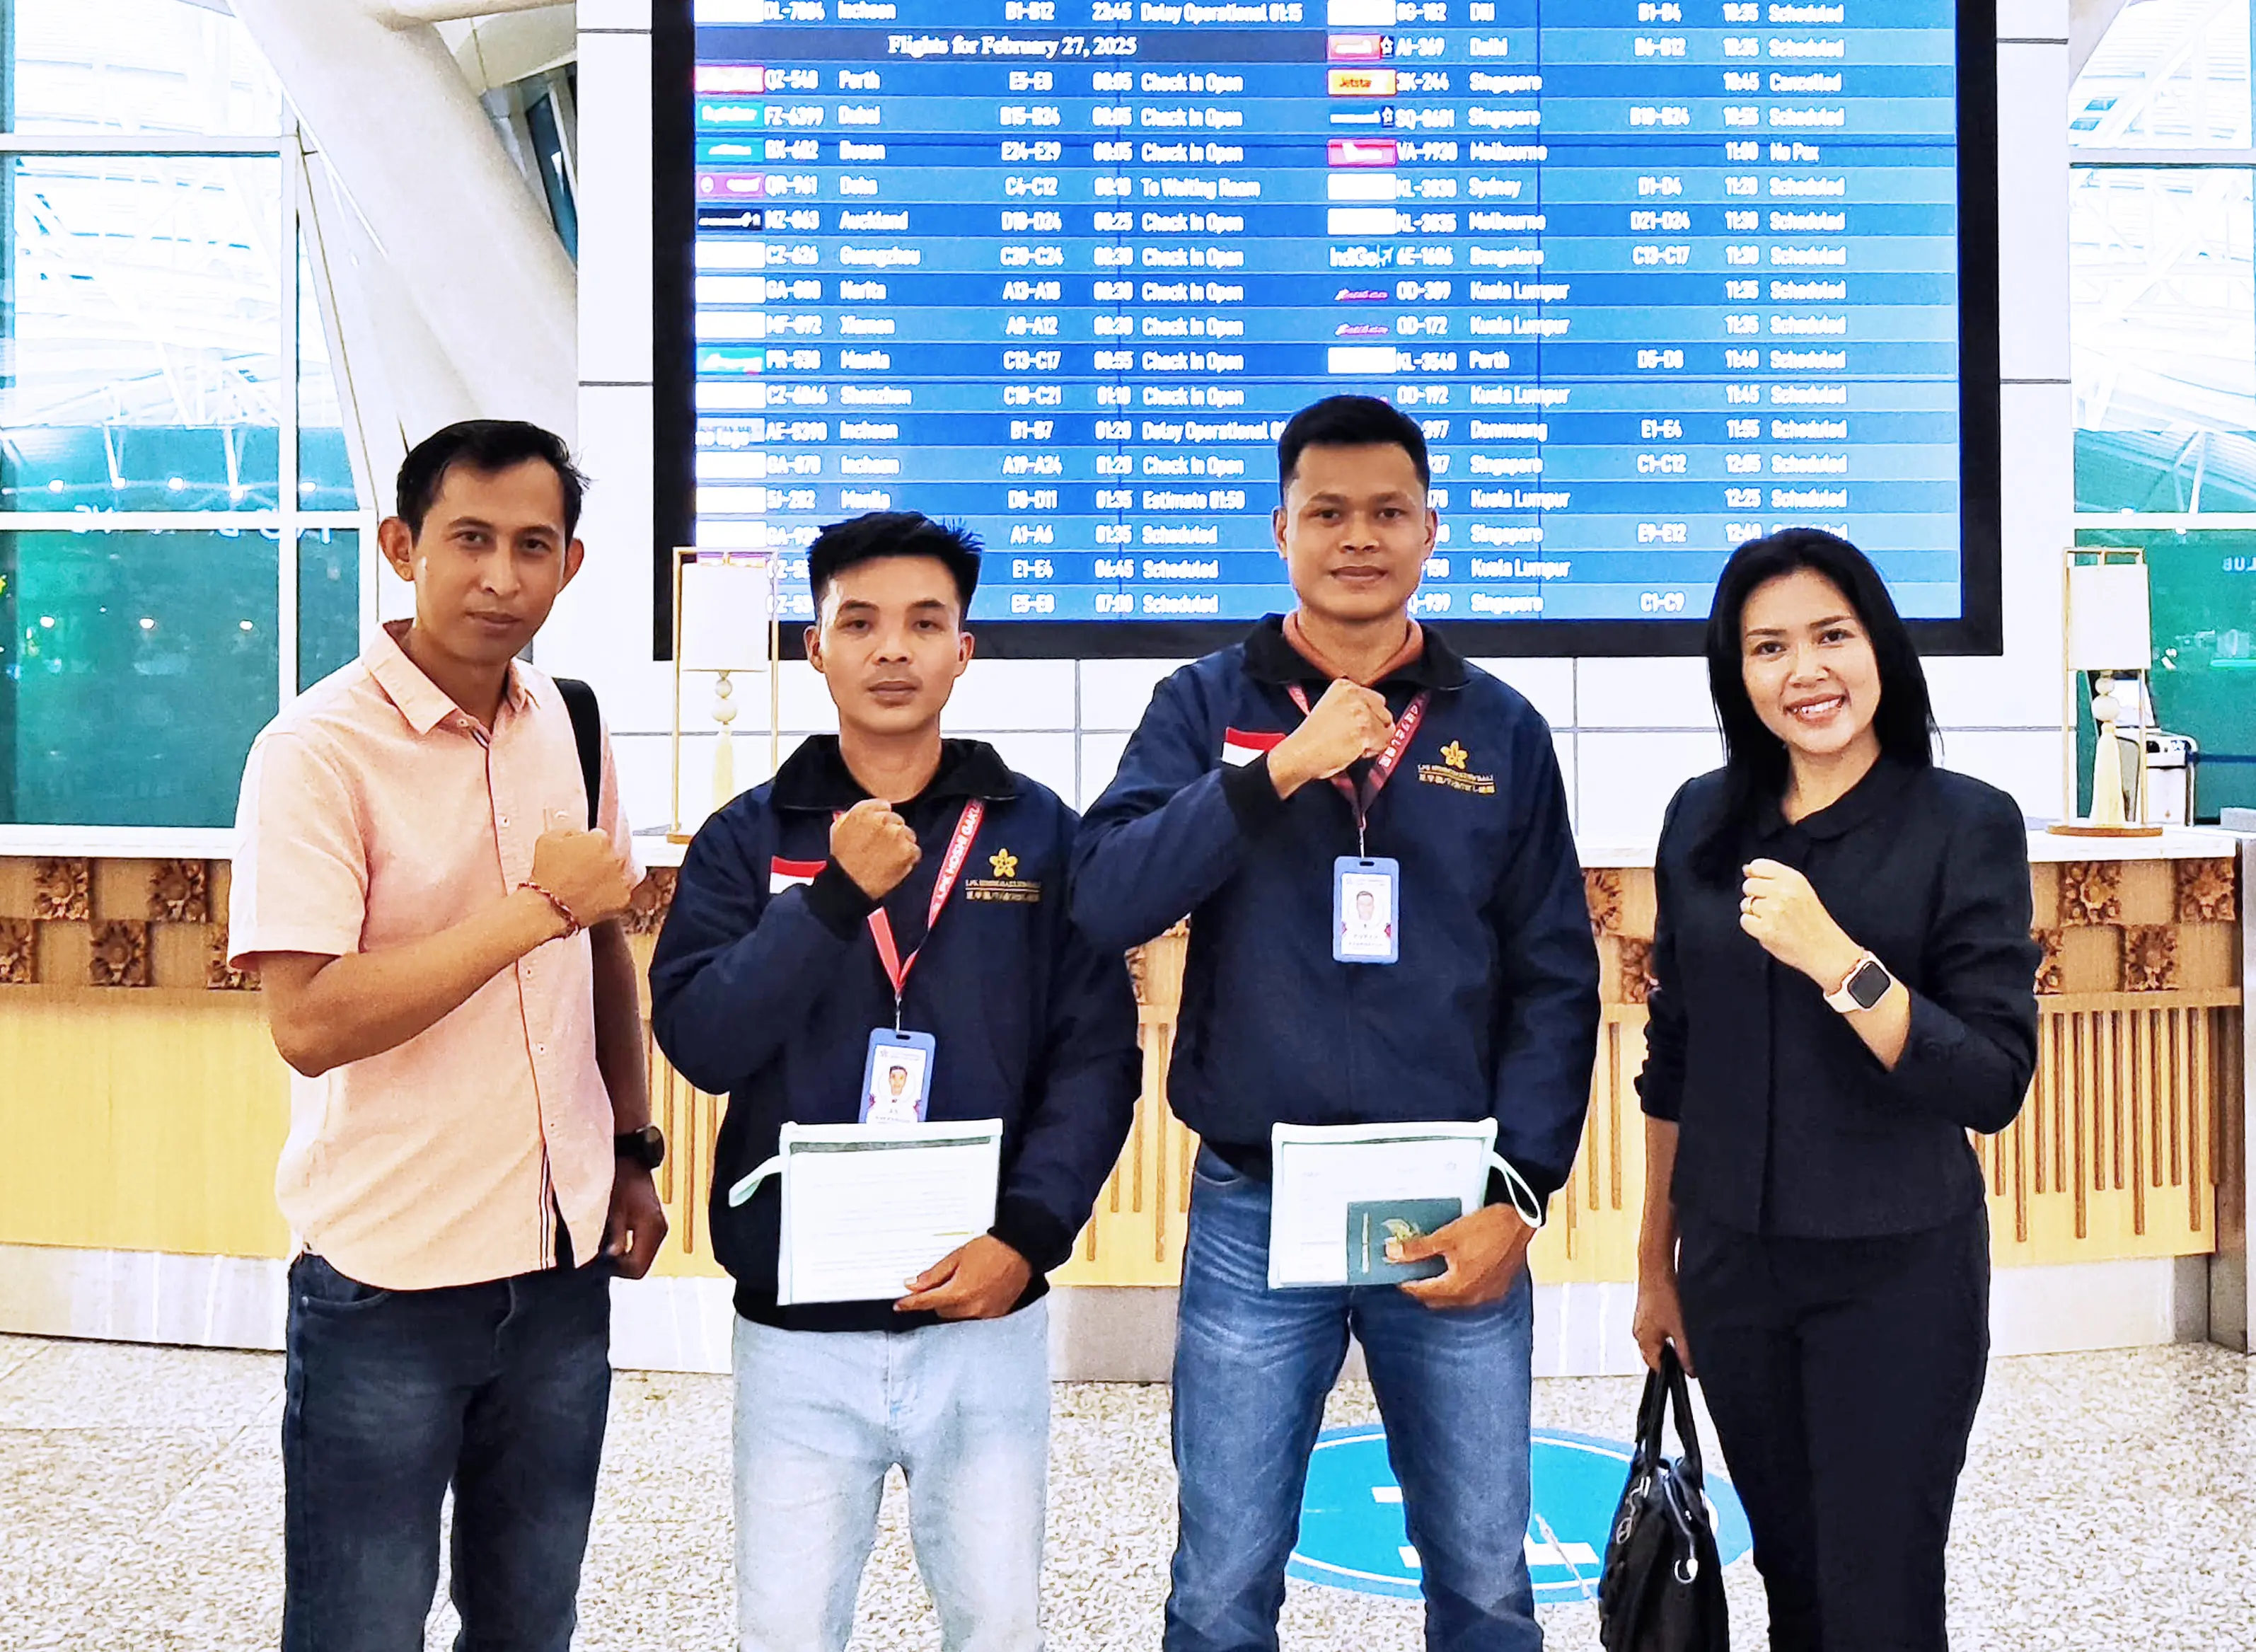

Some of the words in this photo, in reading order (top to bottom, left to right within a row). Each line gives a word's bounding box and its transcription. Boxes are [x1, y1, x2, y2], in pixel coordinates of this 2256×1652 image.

[1140, 2, 1183, 24] Delay
[1184, 2, 1268, 24] Operational
[1768, 4, 1844, 21] Scheduled
[888, 35, 949, 58] Flights
[951, 35, 980, 54] for
[981, 35, 1059, 59] February
[1061, 36, 1090, 58] 27,
[1092, 36, 1137, 55] 2025
[1469, 37, 1508, 57] Delhi
[1768, 37, 1845, 55] Scheduled
[838, 70, 880, 89] Perth
[1141, 72, 1188, 91] Check
[1205, 72, 1244, 93] Open
[1469, 71, 1543, 93] Singapore
[1769, 73, 1842, 90] Cancelled
[838, 105, 881, 125] Dubai
[1140, 108, 1188, 127] Check
[1205, 108, 1243, 128] Open
[1468, 107, 1541, 127] Singapore
[1769, 107, 1845, 125] Scheduled
[1141, 142, 1188, 162] Check
[1205, 142, 1244, 163] Open
[1470, 141, 1548, 162] Melbourne
[840, 175, 878, 195] Doha
[1005, 176, 1058, 196] C4-C12
[1140, 178, 1160, 197] To
[1161, 178, 1217, 198] Waiting
[1218, 178, 1261, 197] Room
[1468, 177, 1522, 197] Sydney
[1769, 177, 1845, 195] Scheduled
[839, 210, 908, 230] Auckland
[1142, 212, 1188, 232] Check
[1205, 212, 1244, 233] Open
[1469, 212, 1546, 231] Melbourne
[1769, 211, 1846, 229] Scheduled
[1142, 247, 1188, 267] Check
[1205, 247, 1244, 268] Open
[1770, 246, 1846, 265] Scheduled
[1142, 282, 1188, 301] Check
[1205, 282, 1244, 303] Open
[1470, 281, 1512, 301] Kuala
[1513, 281, 1570, 302] Lumpur
[1770, 280, 1846, 299] Scheduled
[1142, 316, 1189, 336] Check
[1206, 317, 1244, 337] Open
[1470, 316, 1512, 335] Kuala
[1513, 316, 1570, 337] Lumpur
[1769, 315, 1846, 334] Scheduled
[840, 350, 890, 370] Manila
[1142, 351, 1188, 371] Check
[1206, 352, 1244, 373] Open
[1469, 350, 1510, 369] Perth
[1770, 350, 1846, 369] Scheduled
[1143, 386, 1189, 406] Check
[1206, 386, 1244, 408] Open
[1470, 385, 1512, 405] Kuala
[1514, 386, 1570, 407] Lumpur
[1771, 385, 1847, 404] Scheduled
[1142, 421, 1184, 442] Delay
[1185, 421, 1269, 442] Operational
[1771, 420, 1847, 439] Scheduled
[1143, 455, 1189, 475] Check
[1206, 456, 1244, 477] Open
[1470, 455, 1544, 476] Singapore
[1771, 454, 1848, 473] Scheduled
[840, 490, 891, 509] Manila
[1143, 490, 1208, 509] Estimate
[1471, 490, 1512, 508] Kuala
[1514, 490, 1570, 511] Lumpur
[1771, 490, 1847, 508] Scheduled
[1142, 524, 1217, 544] Scheduled
[1470, 524, 1544, 546] Singapore
[1012, 559, 1053, 578] E1-E4
[1143, 560, 1219, 579] Scheduled
[1471, 559, 1513, 577] Kuala
[1515, 559, 1571, 580] Lumpur
[1143, 594, 1219, 613] Scheduled
[1471, 594, 1544, 615] Singapore
[947, 836, 966, 874] HOSHI
